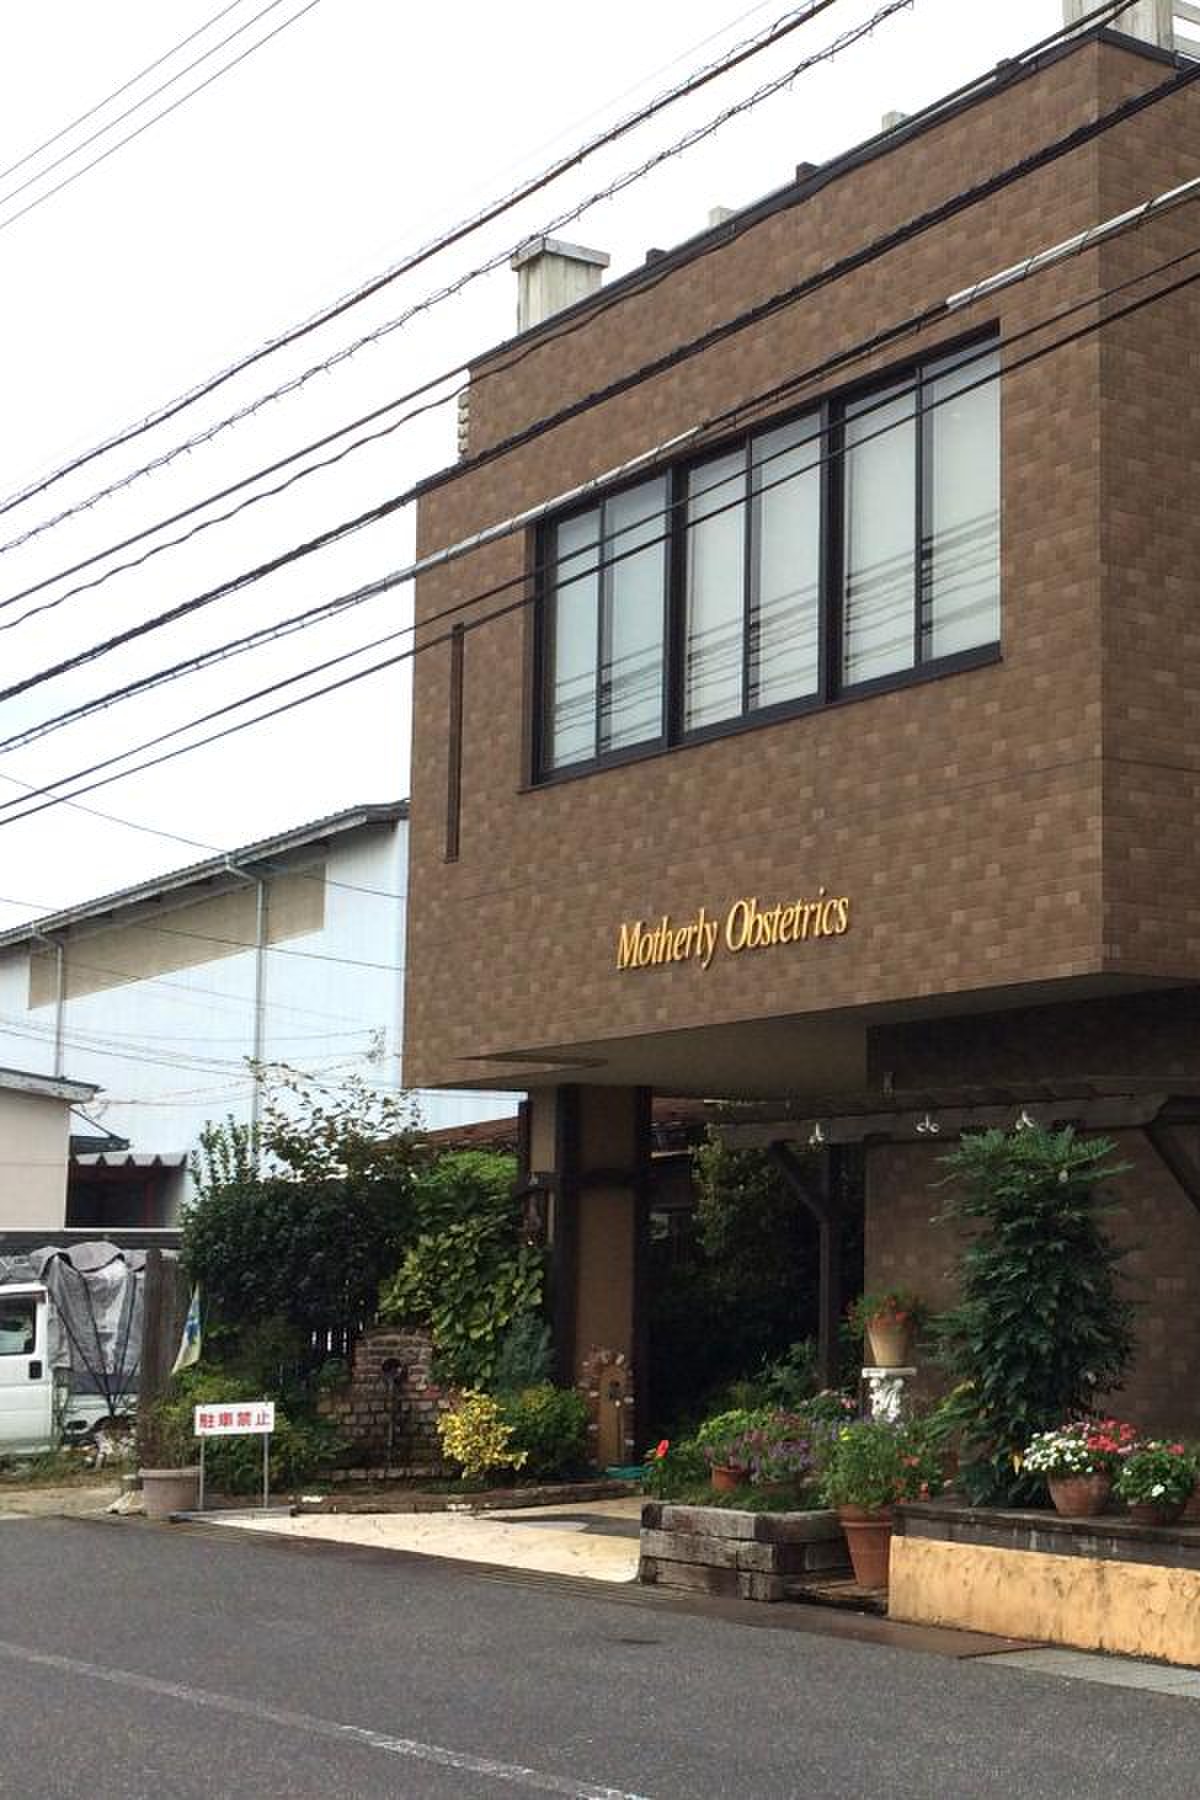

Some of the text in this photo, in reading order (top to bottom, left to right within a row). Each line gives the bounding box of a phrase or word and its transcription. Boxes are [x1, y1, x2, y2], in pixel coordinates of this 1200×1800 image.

[616, 886, 849, 970] Motherly Obstetrics
[199, 1409, 271, 1429] 駐車禁止
